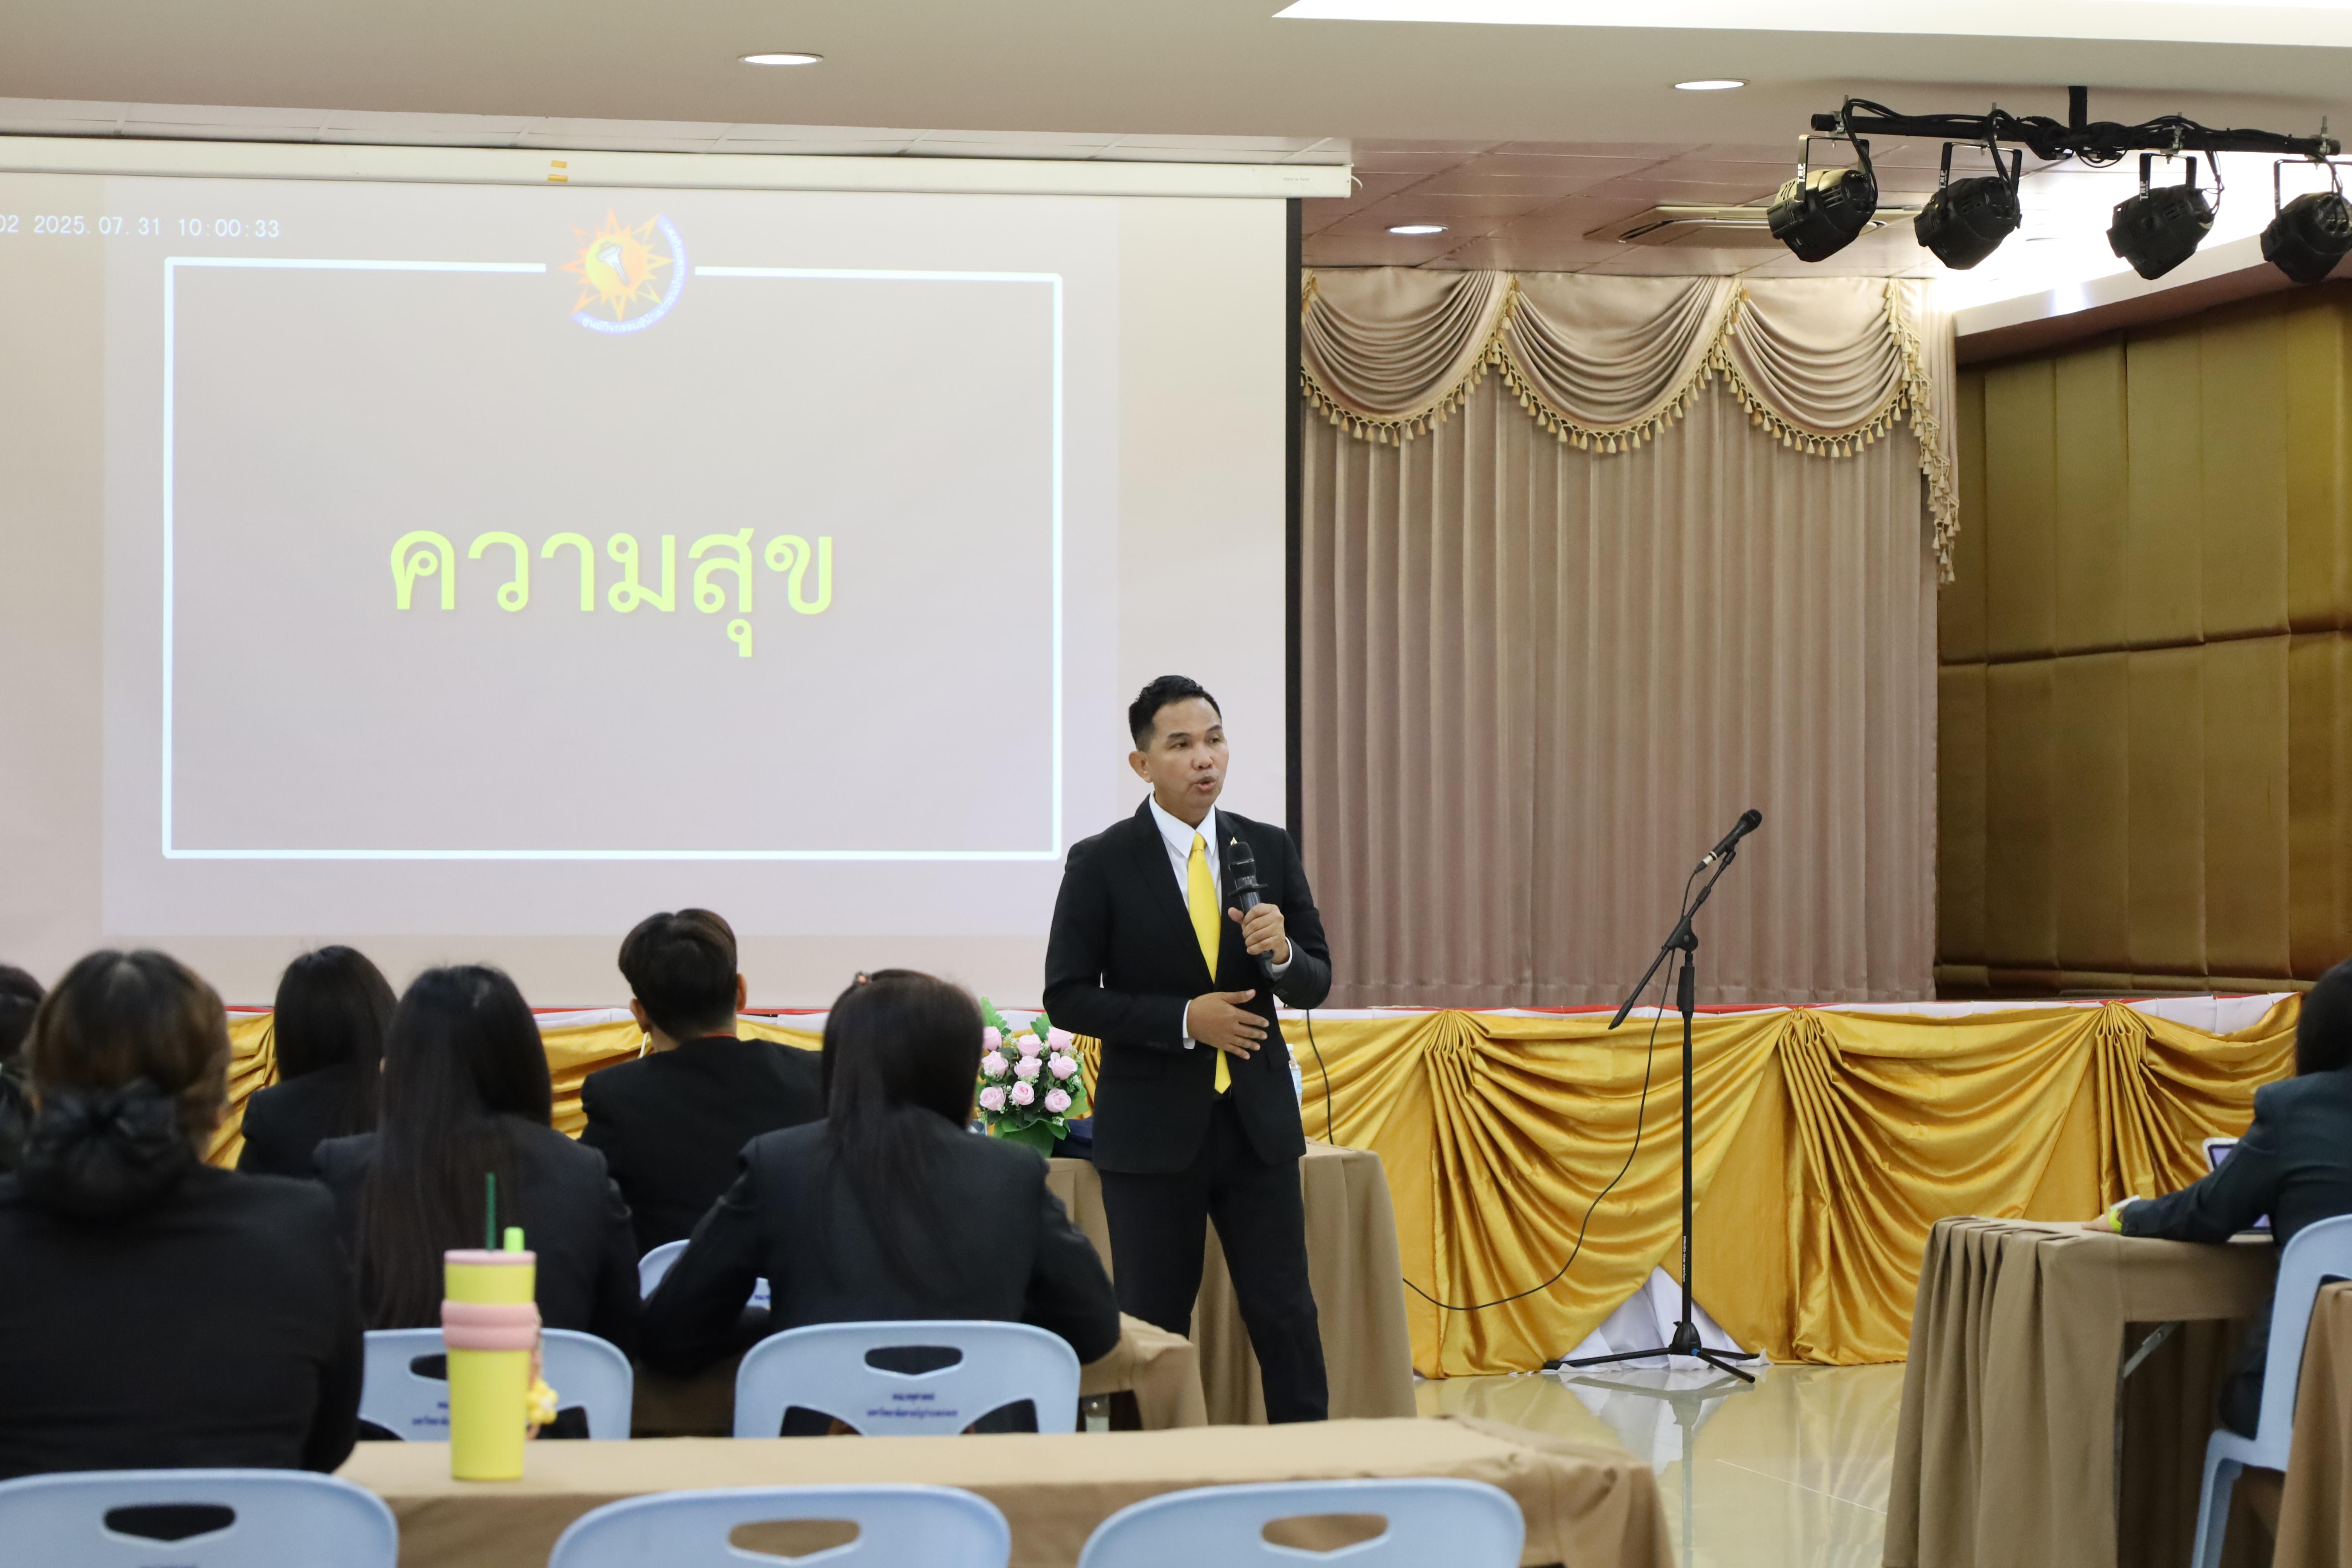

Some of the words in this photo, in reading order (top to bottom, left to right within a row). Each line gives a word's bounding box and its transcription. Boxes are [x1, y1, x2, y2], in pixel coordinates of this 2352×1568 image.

[179, 218, 279, 237] 10:00:33
[390, 528, 833, 657] ความสุข
